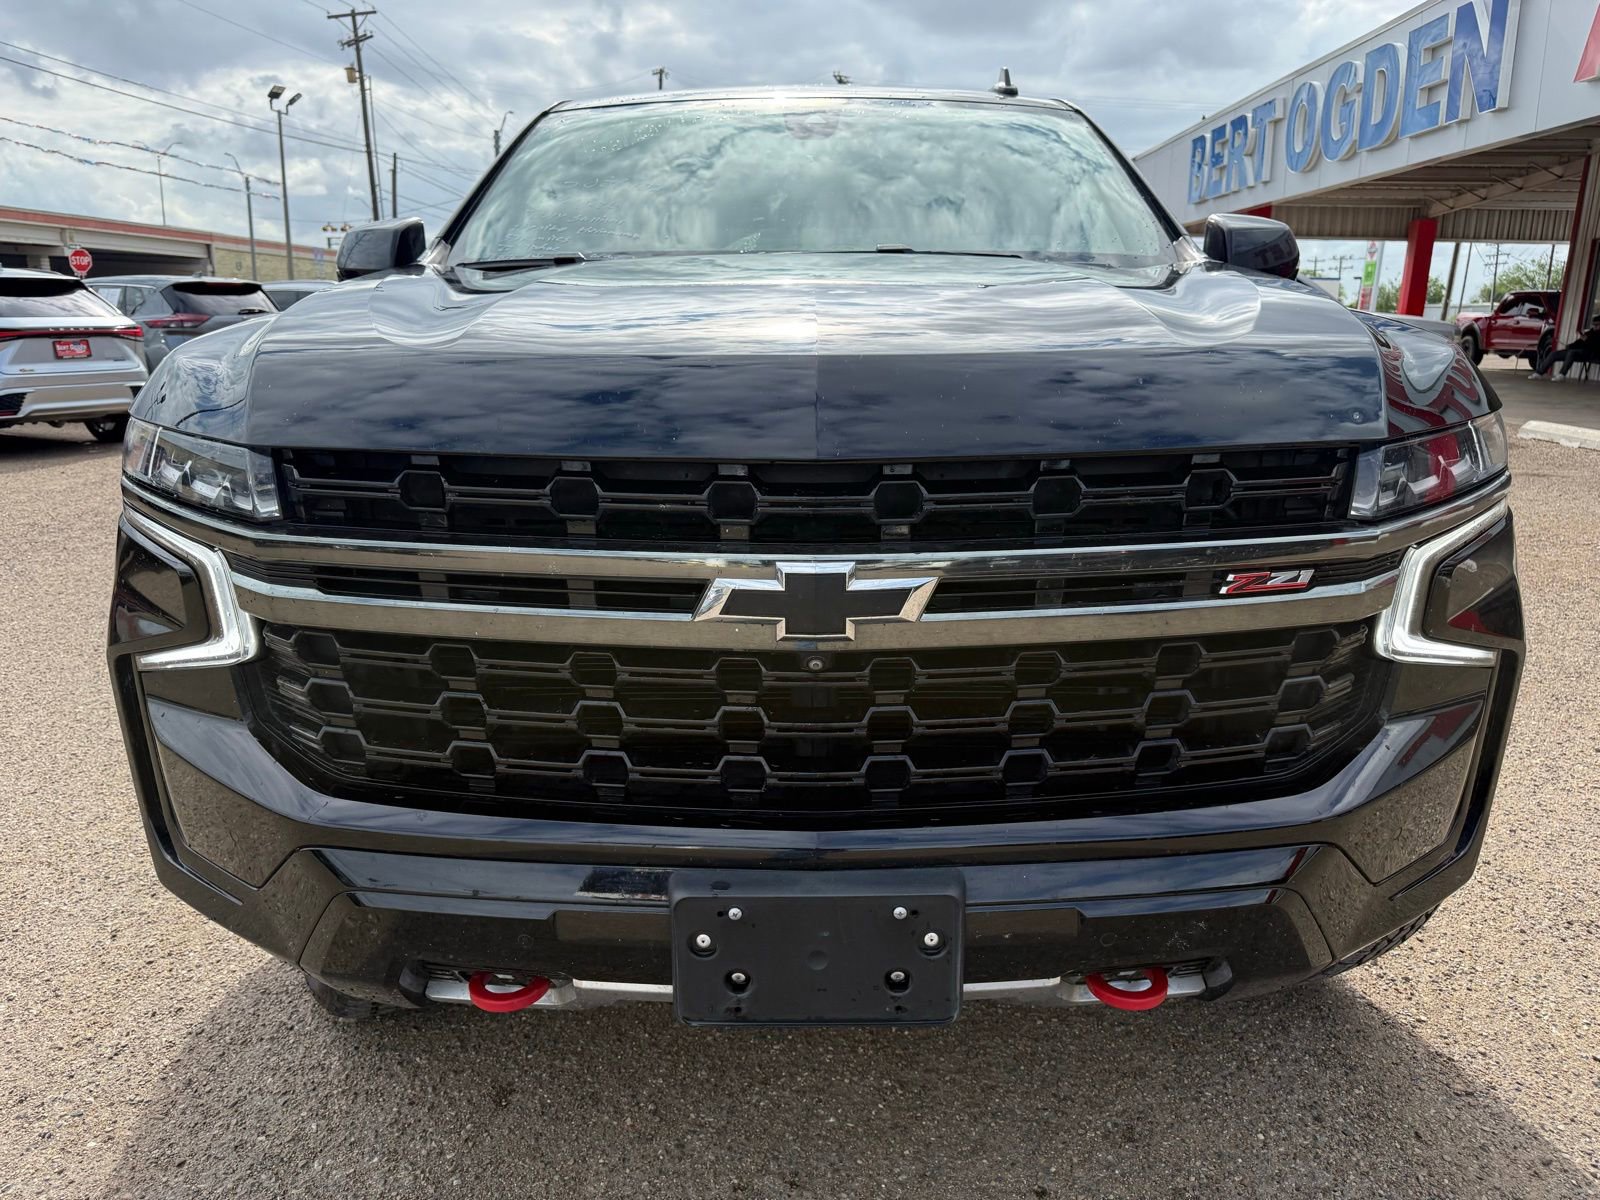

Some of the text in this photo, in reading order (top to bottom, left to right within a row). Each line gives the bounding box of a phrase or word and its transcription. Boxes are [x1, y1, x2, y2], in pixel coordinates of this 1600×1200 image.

[1188, 98, 1284, 204] BERT
[1285, 0, 1519, 173] OGDEN
[71, 256, 90, 265] STOP
[1219, 569, 1315, 594] Z71
